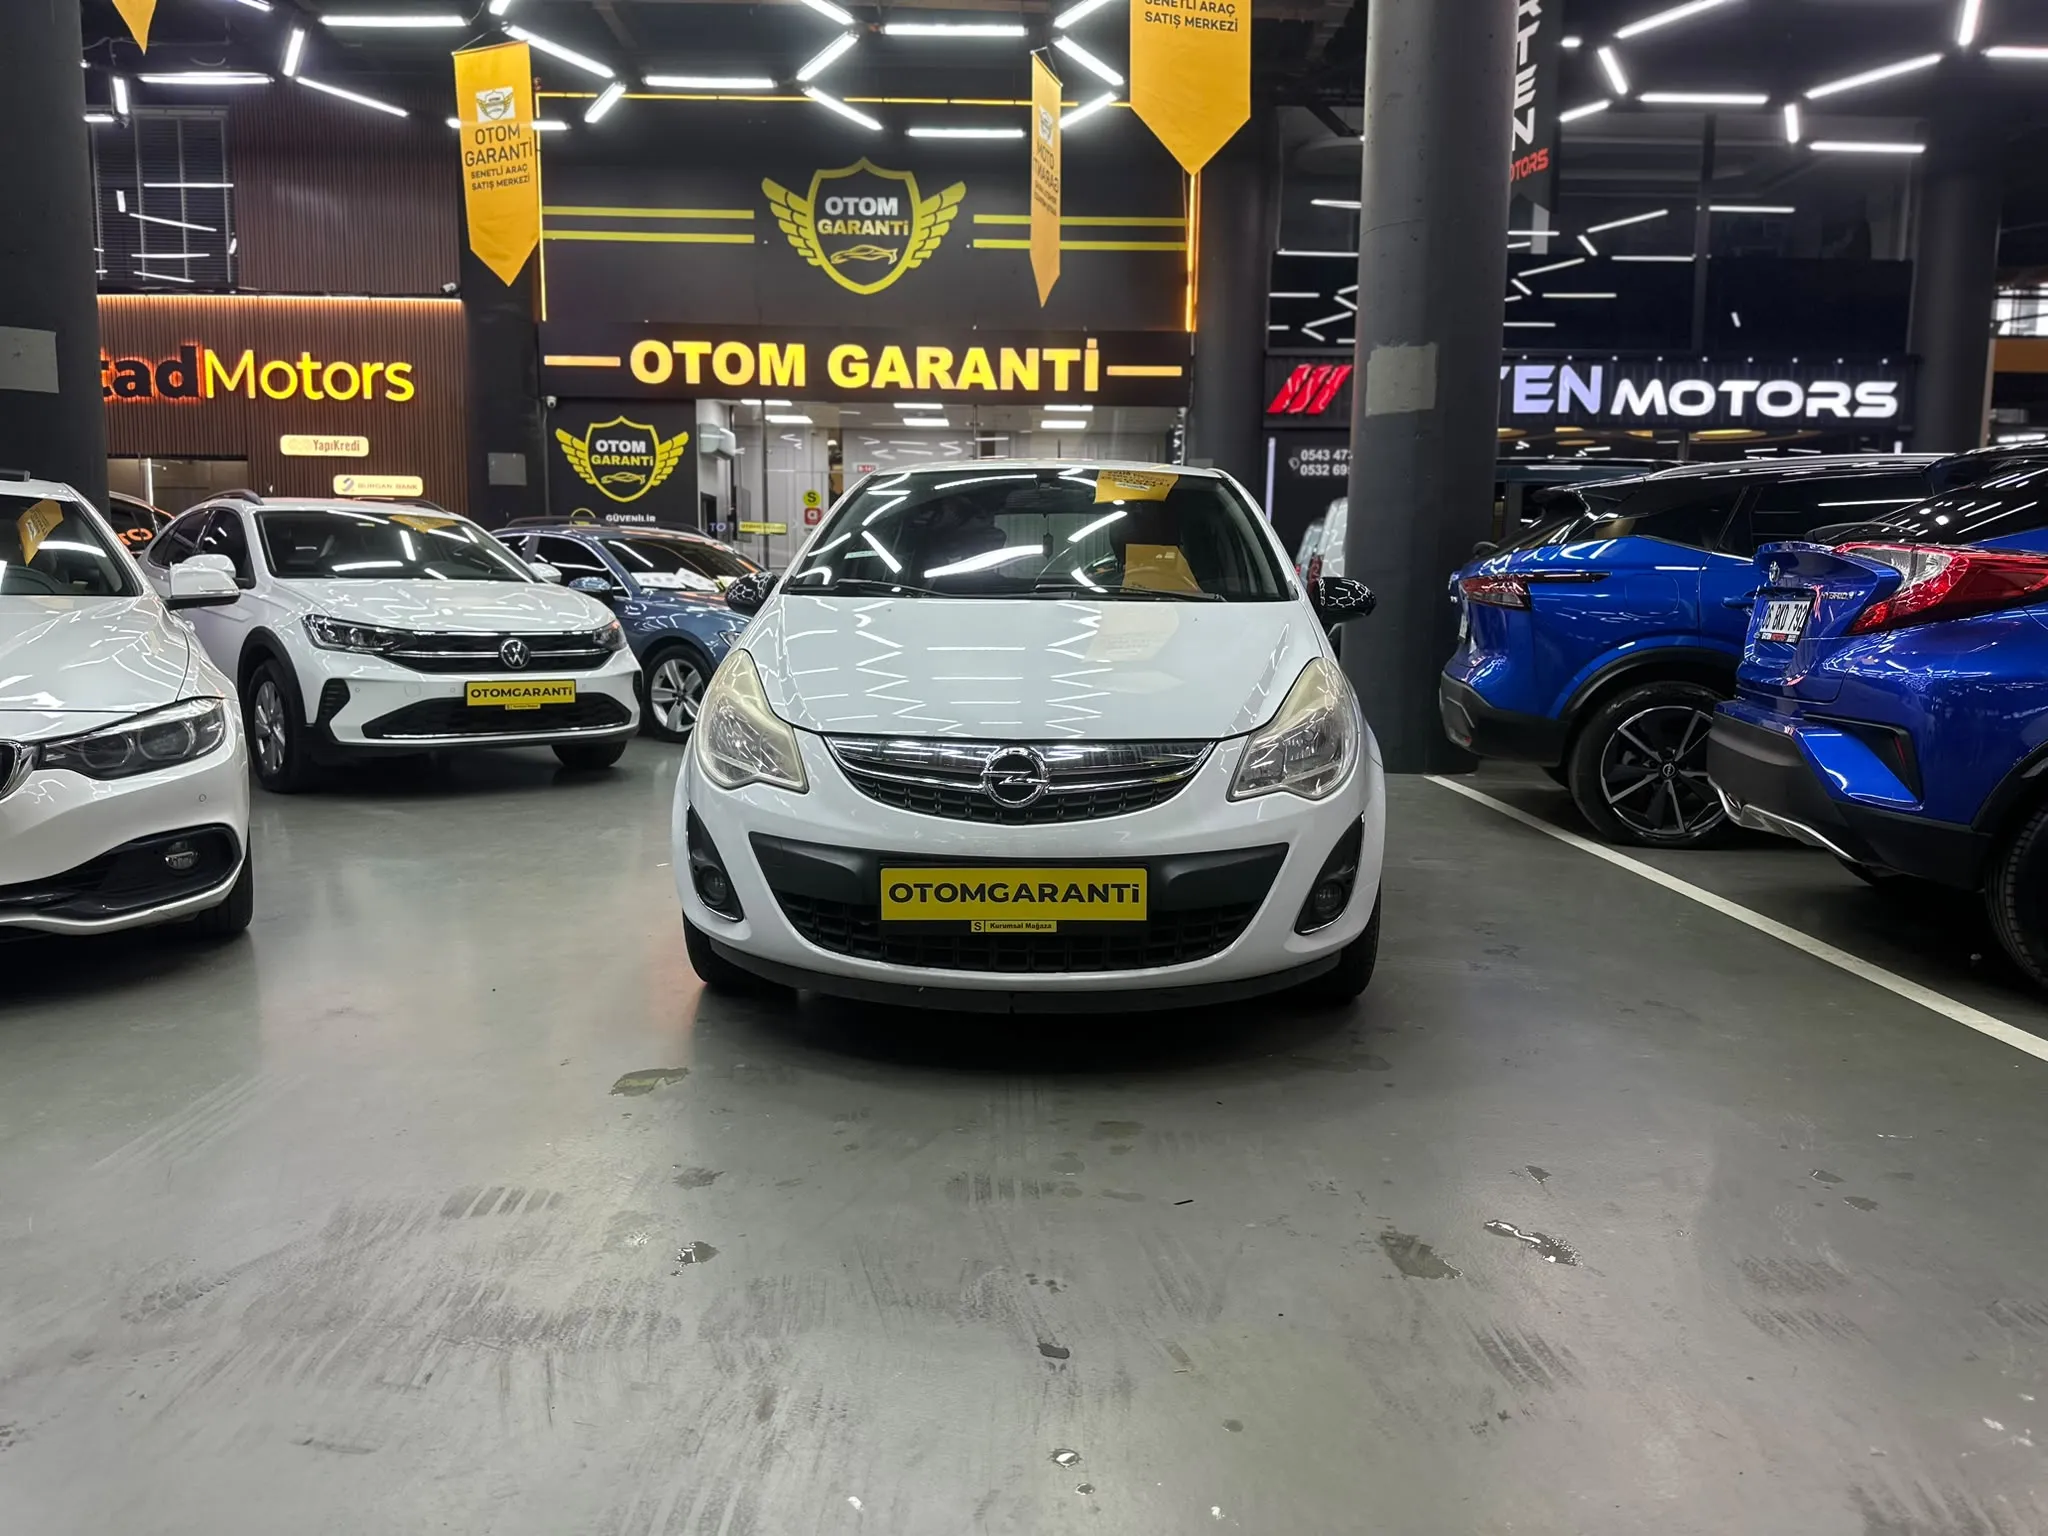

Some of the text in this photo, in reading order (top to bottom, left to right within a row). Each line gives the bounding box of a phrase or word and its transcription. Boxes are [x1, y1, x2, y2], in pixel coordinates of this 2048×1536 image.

[1199, 1, 1235, 17] ARAÇ
[1145, 11, 1238, 32] SATIŞ MERKEZİ
[475, 124, 520, 144] OTOM
[465, 138, 532, 166] GARANTİ
[471, 164, 527, 179] SENETLİ ARAÇ
[471, 174, 530, 192] SATIŞ MERKEZİ
[824, 197, 898, 216] OTOM
[630, 338, 1099, 391] OTOM GARANTİ
[1500, 364, 1898, 417] EN MOTORS
[595, 439, 647, 453] OTOM
[1300, 449, 1330, 461] 0543
[1300, 464, 1330, 476] 0532
[807, 491, 817, 503] S
[1787, 603, 1807, 632] 792
[973, 921, 1052, 931] S Kurumsal Mağaza
